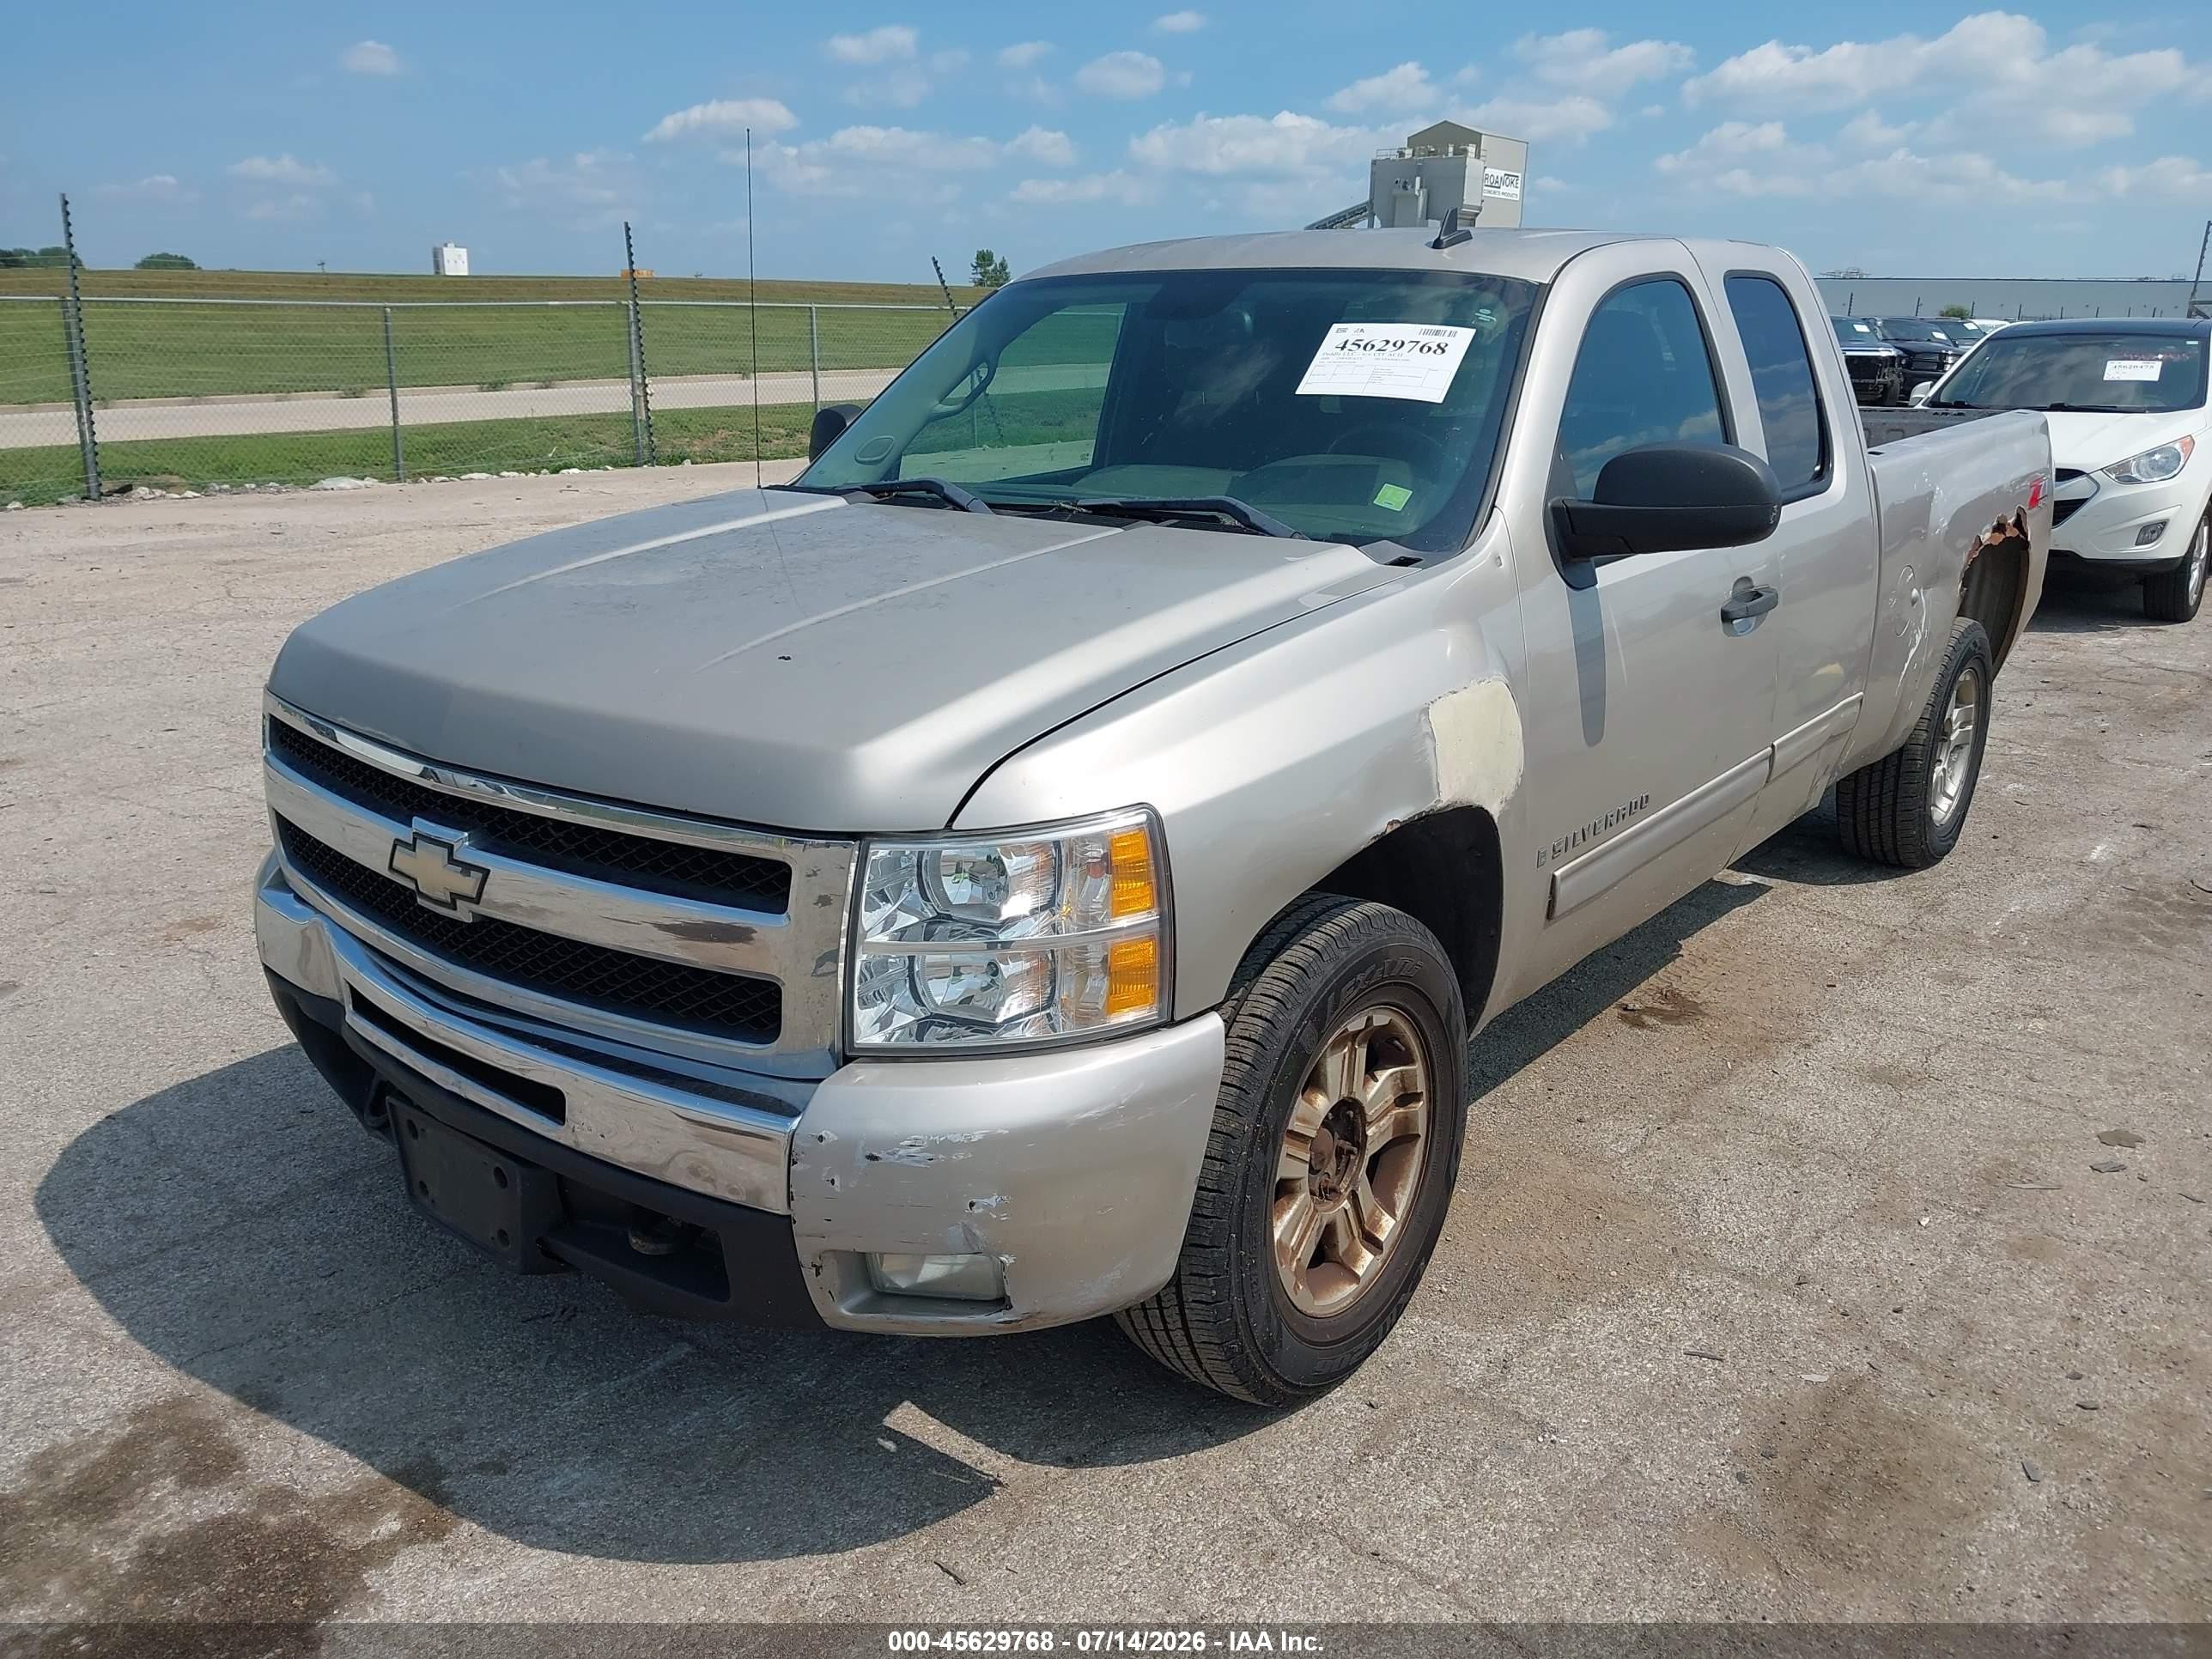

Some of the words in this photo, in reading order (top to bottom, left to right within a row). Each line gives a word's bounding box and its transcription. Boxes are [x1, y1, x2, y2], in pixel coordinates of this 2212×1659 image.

[1484, 173, 1519, 189] ROANOKE
[1334, 338, 1449, 356] 45629768
[1552, 791, 1650, 860] SILVERADO
